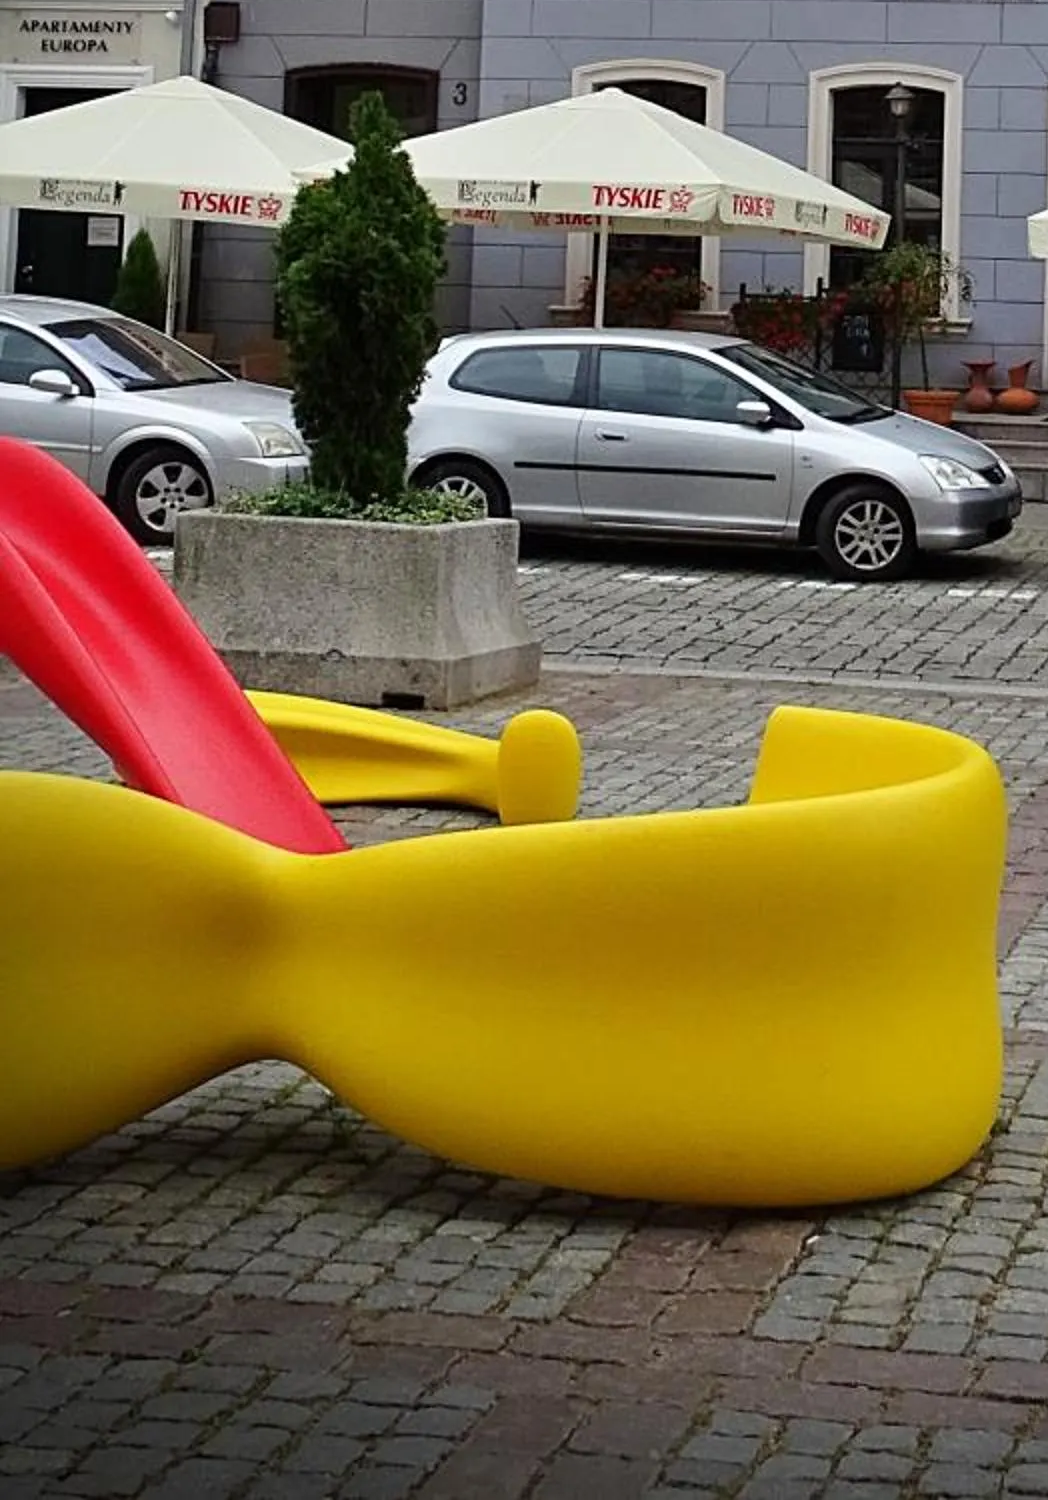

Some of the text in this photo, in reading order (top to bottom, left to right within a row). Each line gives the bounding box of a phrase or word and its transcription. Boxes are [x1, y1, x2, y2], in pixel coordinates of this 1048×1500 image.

[19, 20, 134, 34] APARTAMENTY
[41, 39, 108, 52] EUROPA
[453, 82, 467, 105] 3
[179, 190, 251, 215] TYSKIE
[593, 185, 666, 209] TYSKIE
